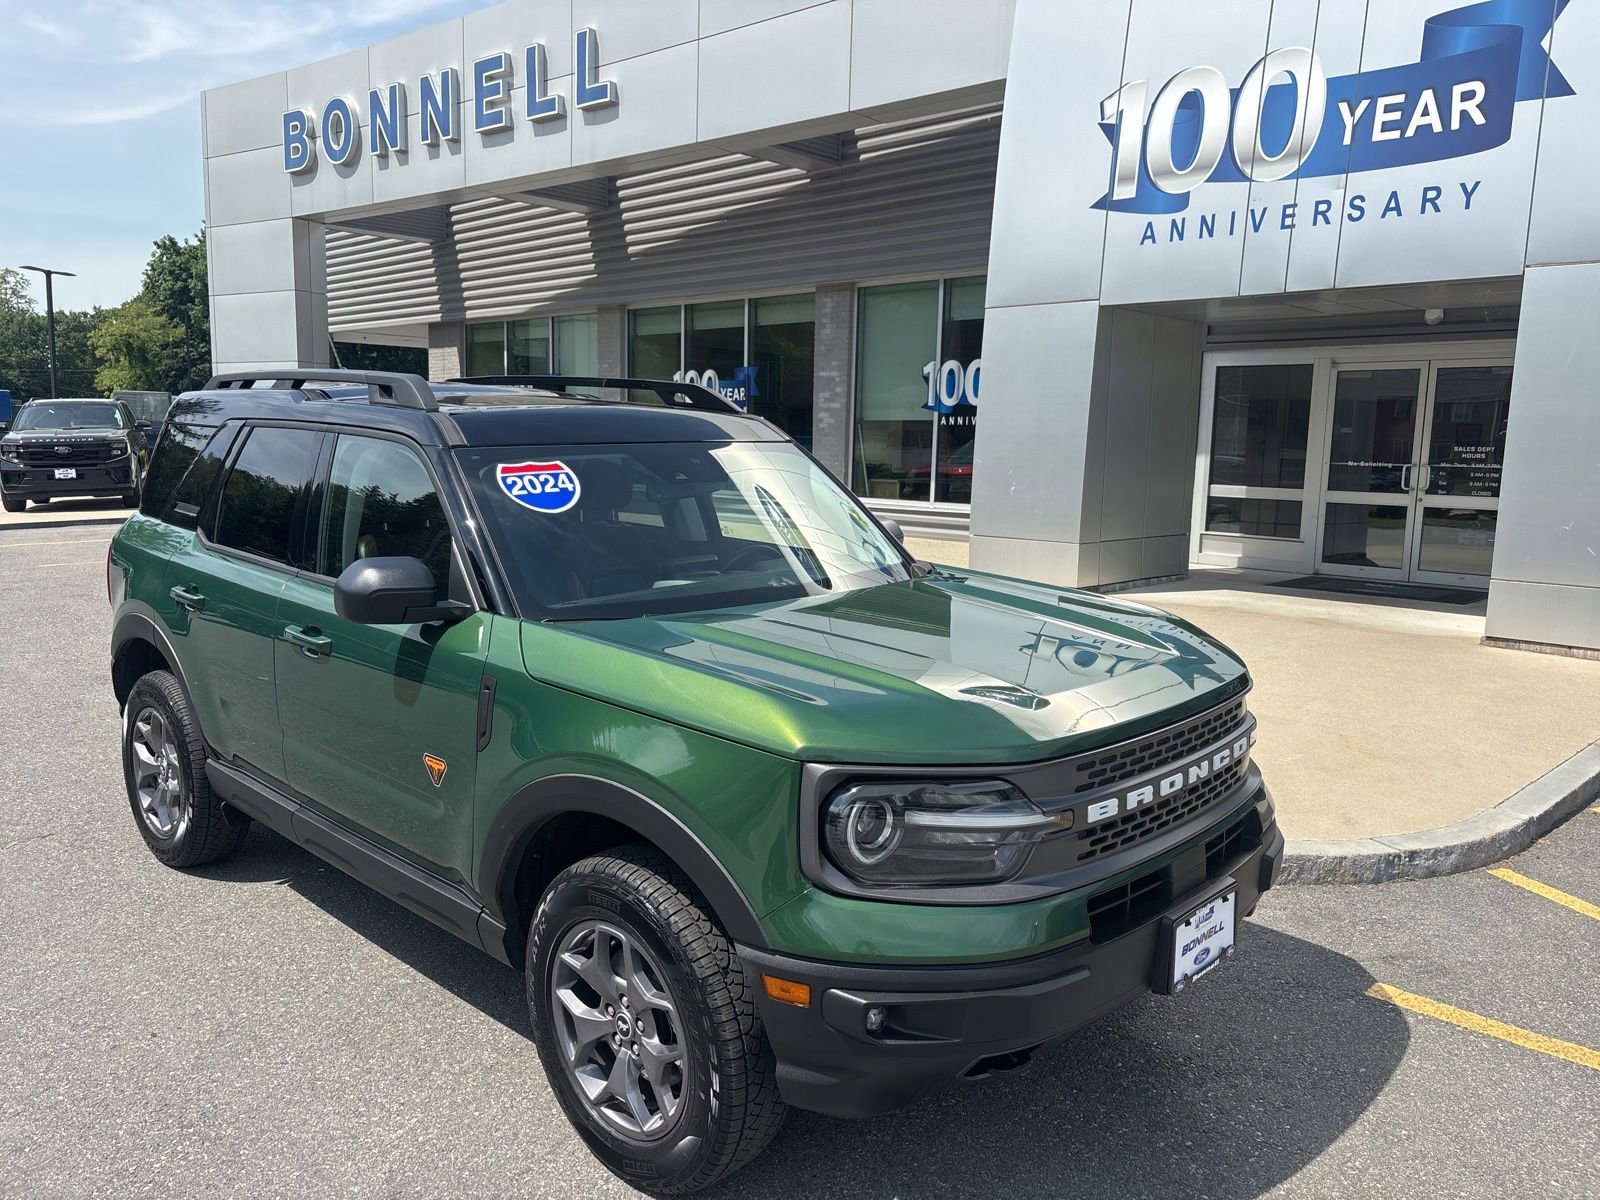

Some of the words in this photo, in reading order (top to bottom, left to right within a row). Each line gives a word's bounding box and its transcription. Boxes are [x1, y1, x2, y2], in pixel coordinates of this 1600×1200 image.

[281, 27, 616, 173] BONNELL
[1099, 46, 1327, 201] 100
[1337, 80, 1487, 146] YEAR
[1139, 181, 1482, 245] ANNIVERSARY
[505, 473, 575, 496] 2024
[1087, 737, 1249, 824] BRONCO
[1181, 920, 1225, 957] BONNELL
